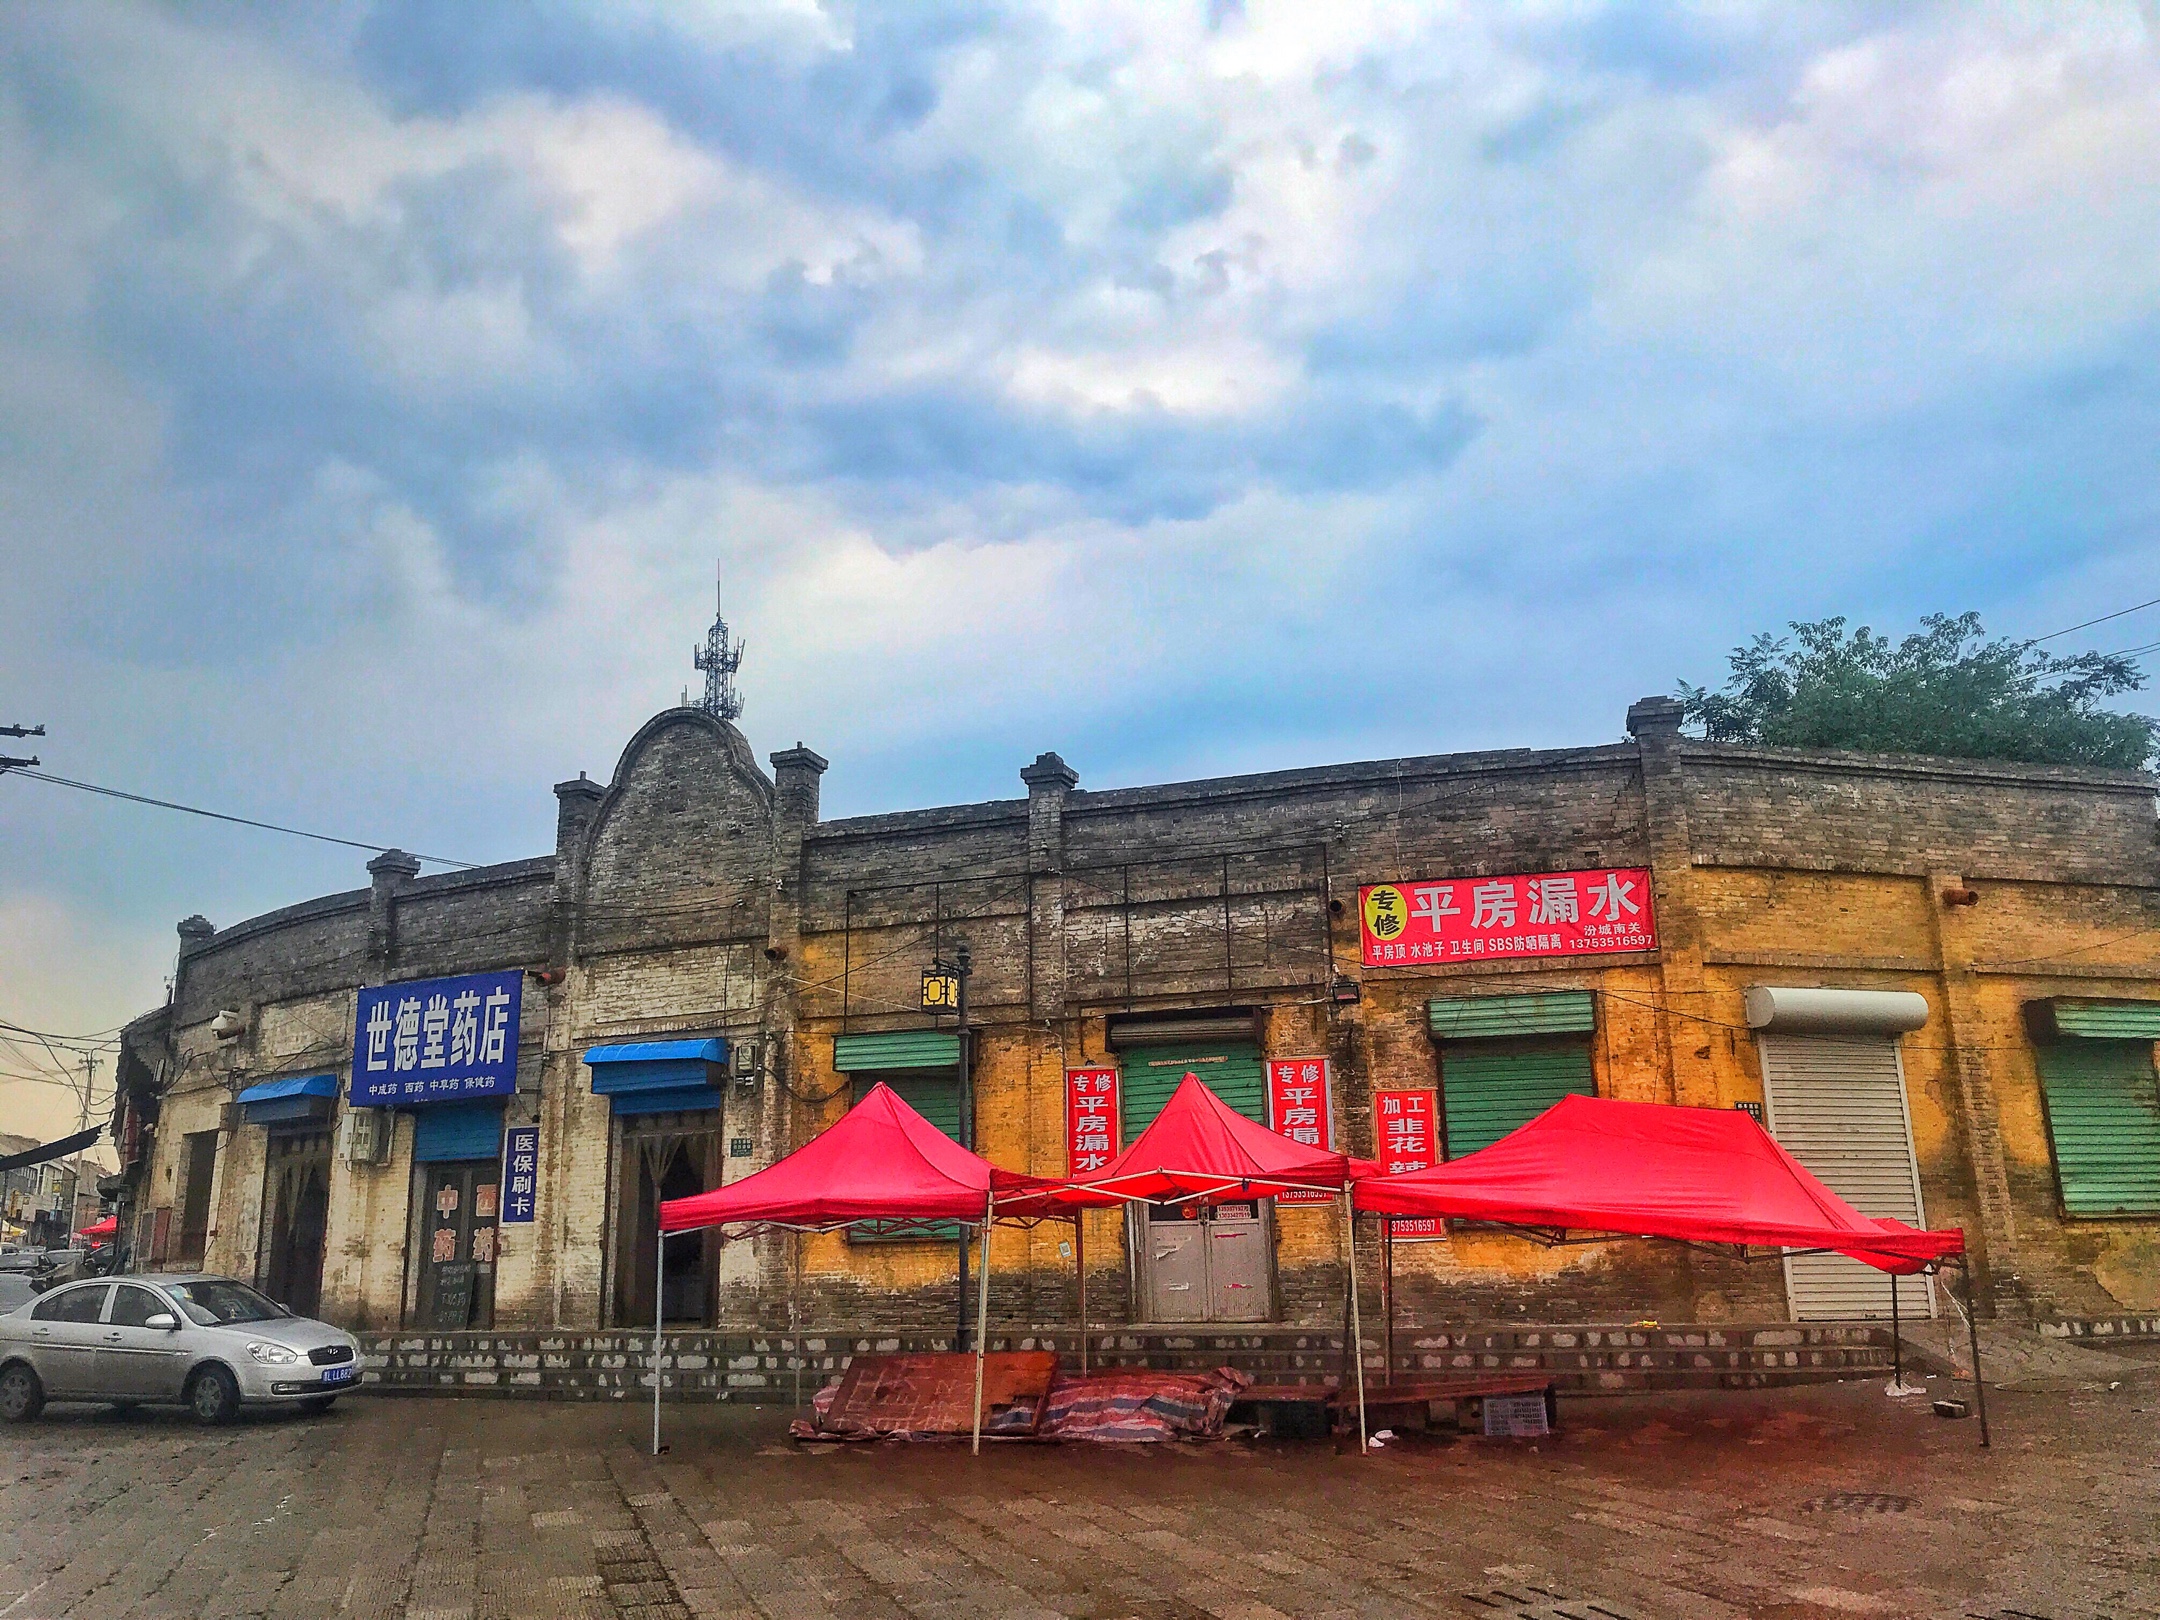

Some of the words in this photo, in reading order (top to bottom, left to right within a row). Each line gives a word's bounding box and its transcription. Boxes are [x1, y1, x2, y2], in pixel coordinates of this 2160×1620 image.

[1371, 889, 1400, 937] 专修
[1411, 874, 1641, 933] 平房漏水
[1372, 943, 1406, 960] 平房顶
[1411, 943, 1445, 958] 水池子
[1450, 939, 1485, 955] 卫生间
[1489, 933, 1562, 952] SBS防晒隔离
[1569, 935, 1652, 949] 13753516597
[1584, 922, 1641, 936] 汾城南关
[366, 985, 510, 1072] 世德堂药店
[369, 1083, 398, 1096] 中成药
[405, 1081, 424, 1094] 西药
[430, 1079, 460, 1091] 中草药
[464, 1076, 495, 1088] 保健药
[1074, 1074, 1112, 1093] 专修
[1278, 1064, 1319, 1084] 专修
[1280, 1087, 1320, 1144] 平房漏
[1383, 1096, 1426, 1114] 加工
[1075, 1096, 1109, 1171] 平房漏水
[511, 1134, 534, 1216] 医保刷卡
[433, 1184, 459, 1263] 中药
[473, 1184, 497, 1262] 西药
[1391, 1219, 1436, 1232] 3753516597
